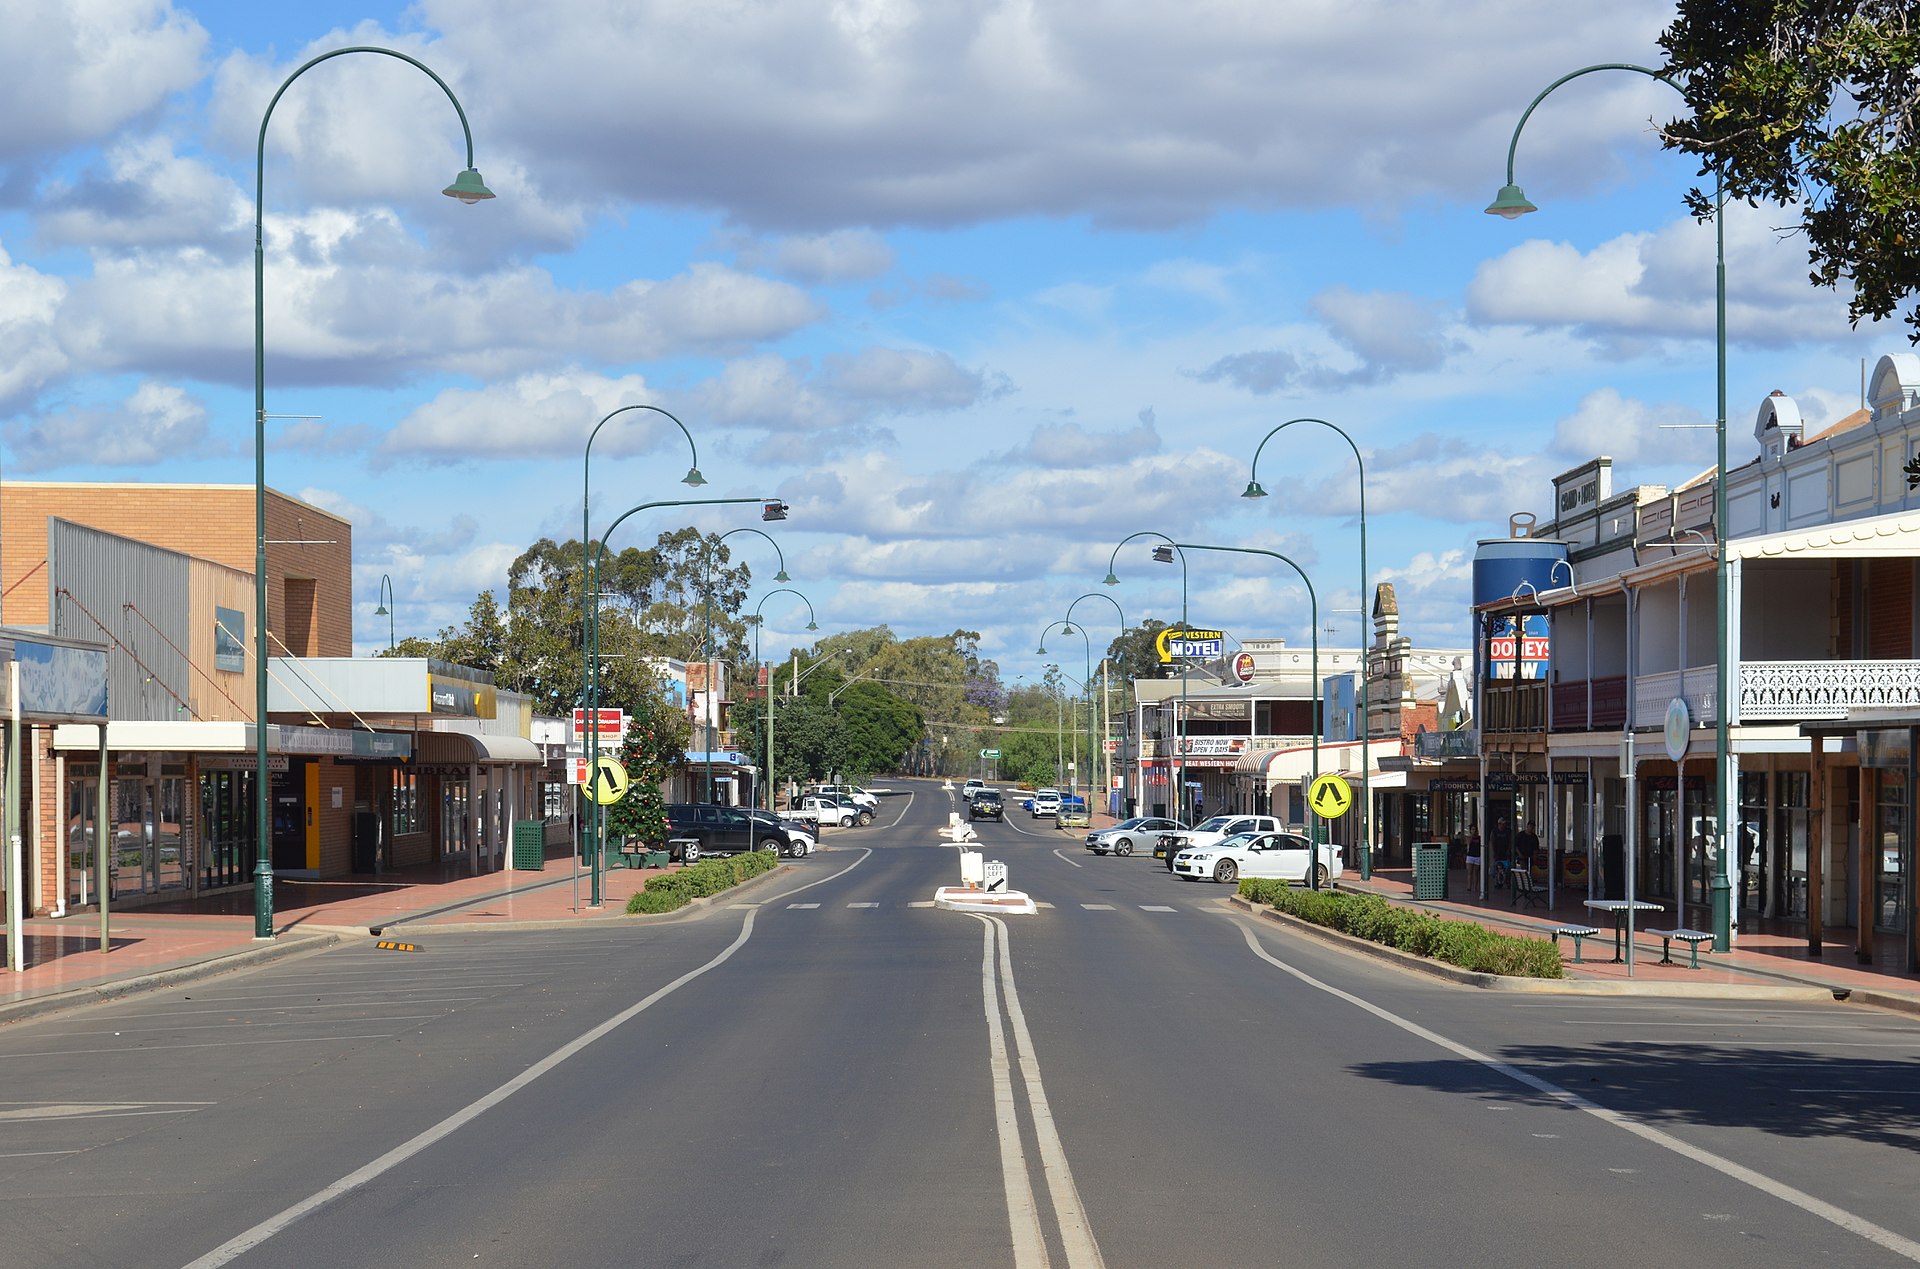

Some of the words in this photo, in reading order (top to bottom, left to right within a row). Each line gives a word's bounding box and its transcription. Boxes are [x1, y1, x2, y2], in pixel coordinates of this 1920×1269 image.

[1560, 488, 1577, 512] GRAND
[1580, 480, 1596, 505] HOTEL
[1171, 642, 1219, 656] MOTEL
[1490, 641, 1549, 657] OOHEYS
[1496, 662, 1538, 679] NEW
[1476, 782, 1496, 790] NW
[1541, 774, 1564, 783] NW
